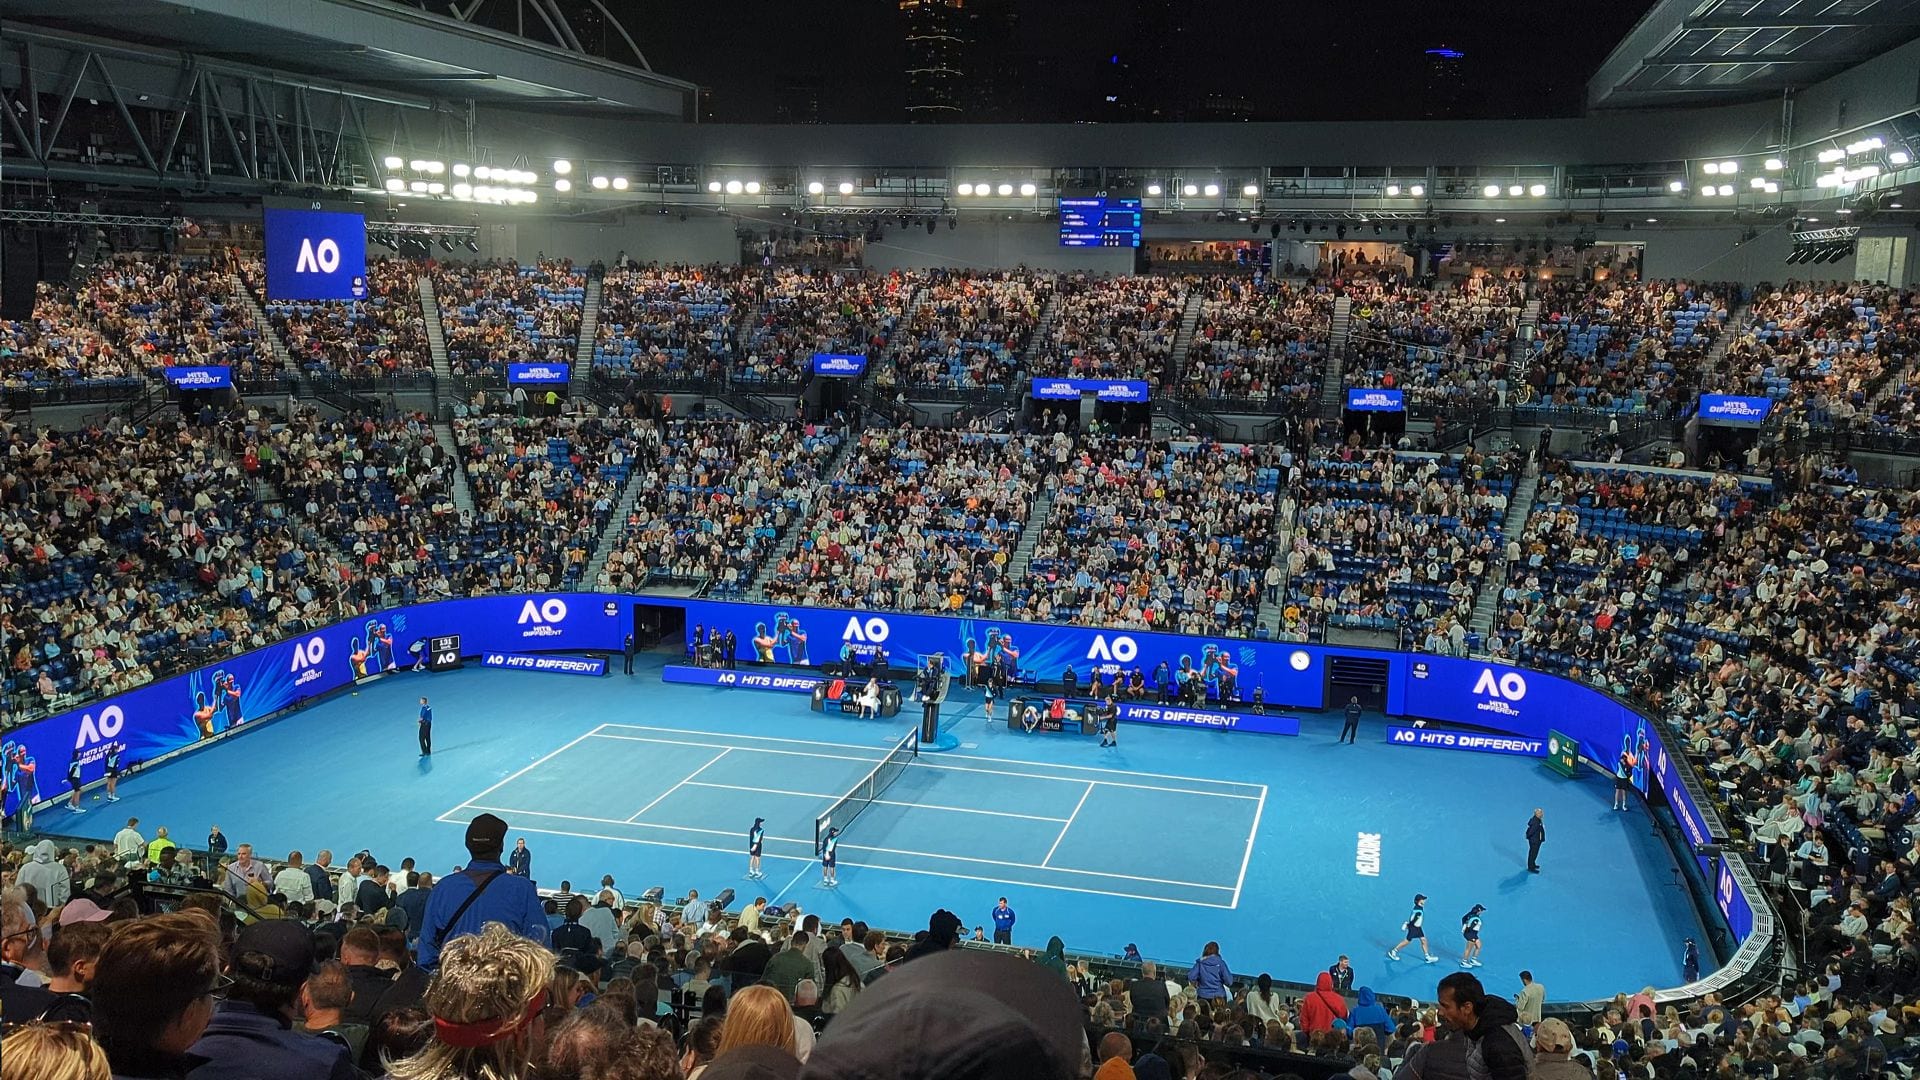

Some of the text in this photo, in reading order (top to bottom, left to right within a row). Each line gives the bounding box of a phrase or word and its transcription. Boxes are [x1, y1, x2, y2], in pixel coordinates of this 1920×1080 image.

[312, 202, 321, 210] AO
[296, 238, 340, 273] AO
[174, 376, 222, 385] DIFFERENT
[1098, 390, 1141, 398] DIFFERENT
[1352, 399, 1400, 407] DIFFERENT
[1709, 406, 1762, 416] DIFFERENT
[1723, 400, 1748, 409] HITS
[518, 598, 566, 625] AO
[842, 616, 889, 643] AO
[291, 636, 325, 672] AO
[1087, 634, 1138, 662] AO
[437, 652, 456, 665] AO
[487, 654, 600, 672] AO HITS DIFFERENT
[718, 673, 824, 689] AO HITS DIFFER
[1472, 668, 1527, 701] AO
[1477, 703, 1520, 717] DIFFERENT
[1489, 700, 1509, 709] HITS
[1128, 708, 1160, 719] HITS
[1163, 710, 1240, 727] DIFFERENT
[75, 704, 124, 749] AO
[1394, 730, 1542, 753] AO HITS DIFFERENT
